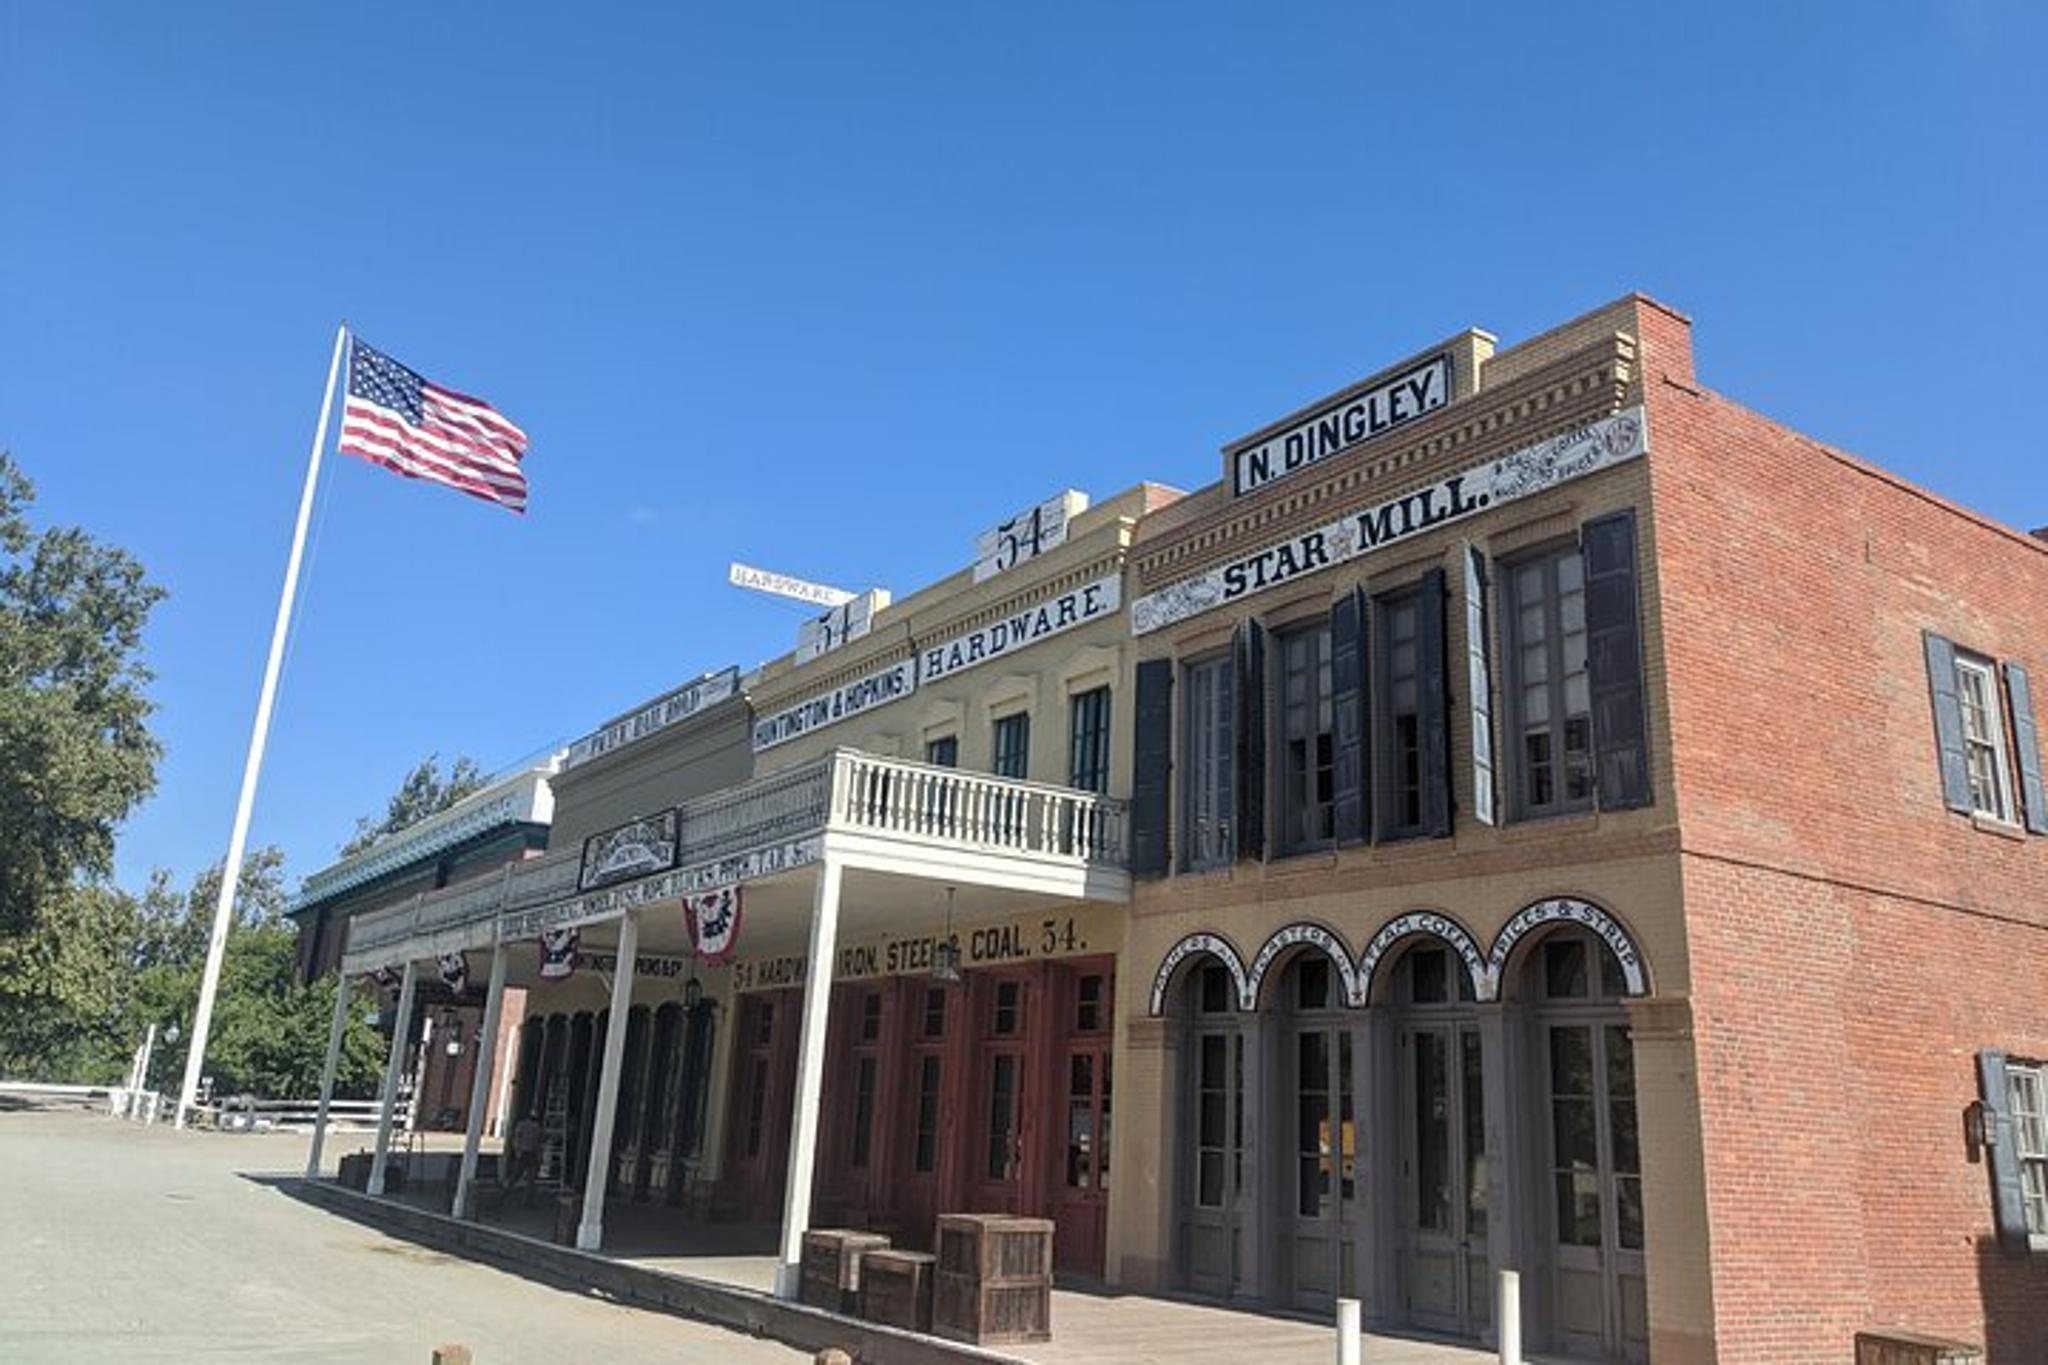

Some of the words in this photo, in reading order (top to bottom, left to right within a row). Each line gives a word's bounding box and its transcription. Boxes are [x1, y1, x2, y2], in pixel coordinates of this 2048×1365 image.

[1249, 446, 1276, 487] N.
[1285, 369, 1438, 471] DINGLEY.
[997, 506, 1042, 571] 54
[1223, 532, 1330, 599] STAR
[1356, 476, 1490, 551] MILL.
[926, 584, 1107, 678] HARDWARE.
[833, 689, 843, 718] &
[972, 924, 1031, 962] COAL.
[1042, 917, 1088, 952] 54.
[1557, 900, 1573, 917] &
[1581, 905, 1637, 966] SYRUP
